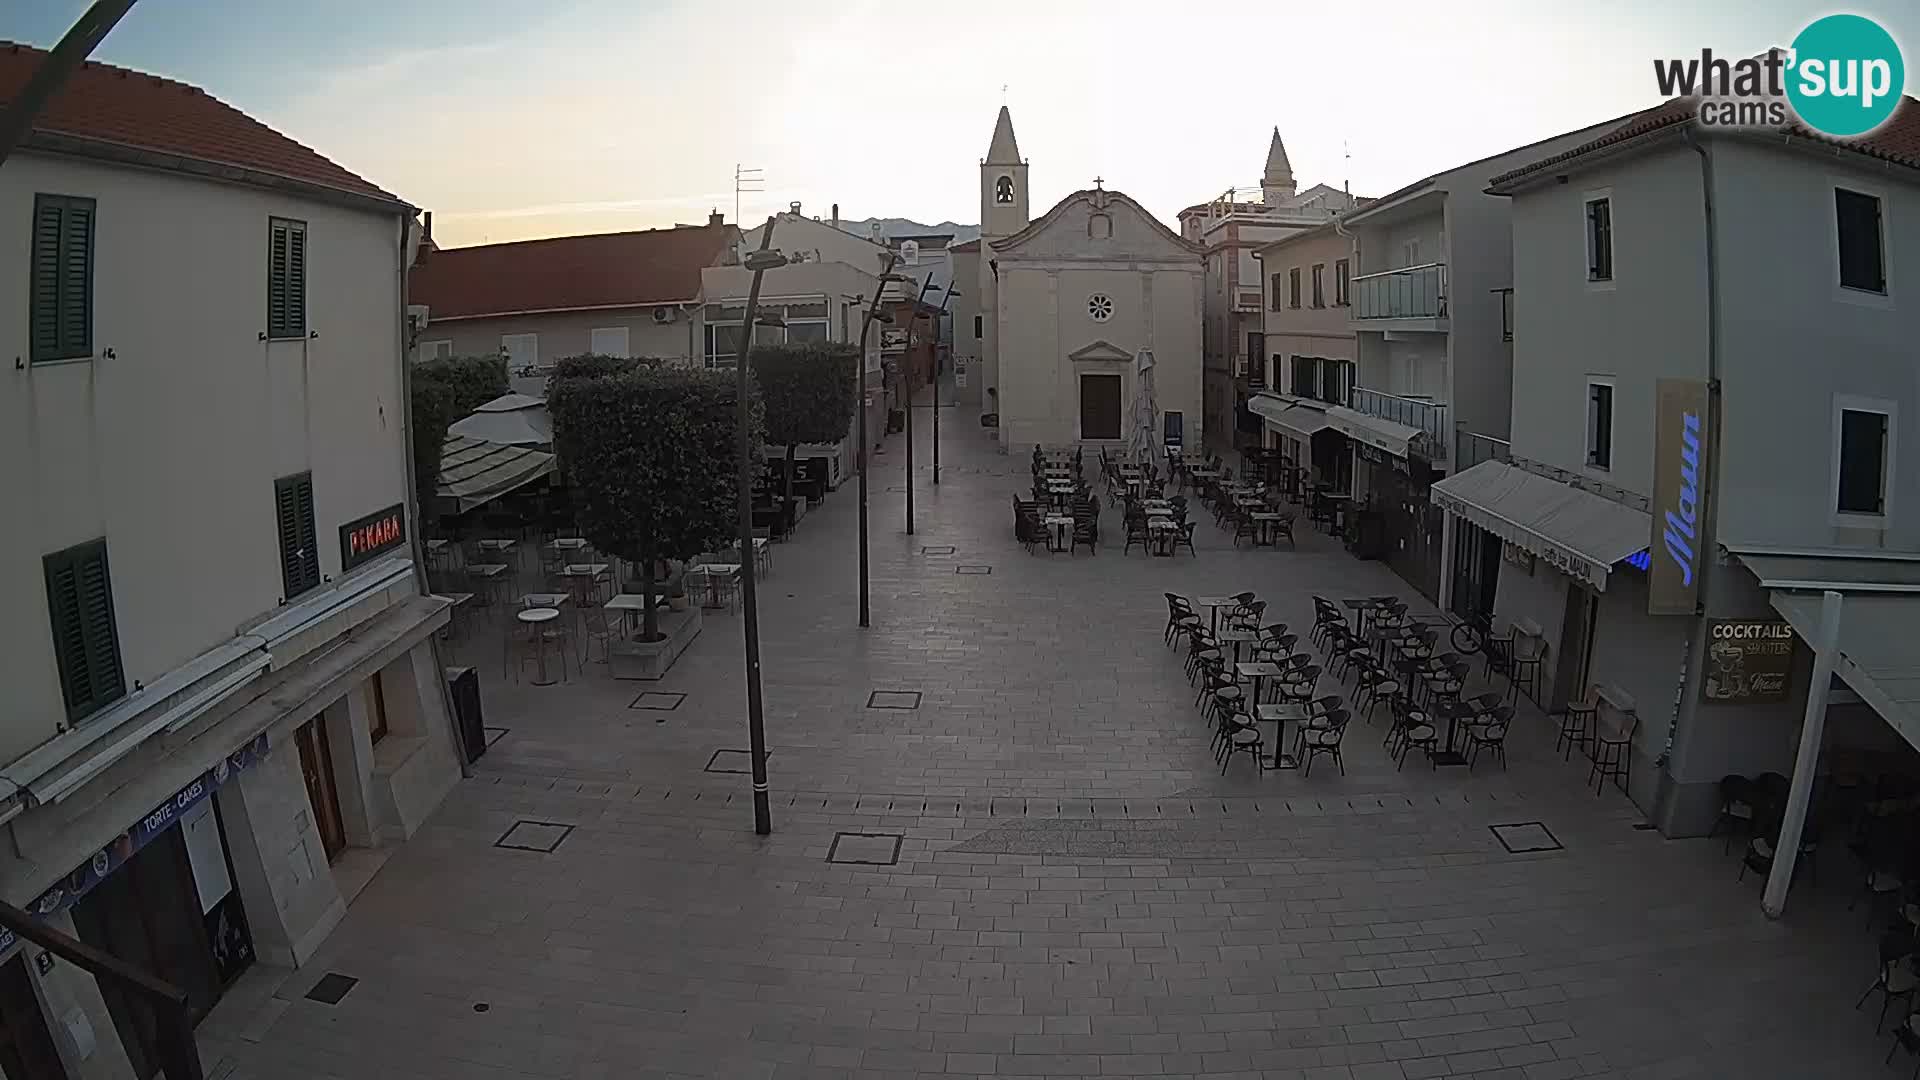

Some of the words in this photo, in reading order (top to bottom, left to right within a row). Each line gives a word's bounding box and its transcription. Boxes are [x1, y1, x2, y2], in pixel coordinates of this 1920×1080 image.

[1664, 411, 1701, 587] Maun
[350, 514, 401, 556] PEKARA
[1712, 624, 1793, 639] COCKTAILS
[144, 803, 173, 833] TORTE
[177, 781, 203, 808] CAKES
